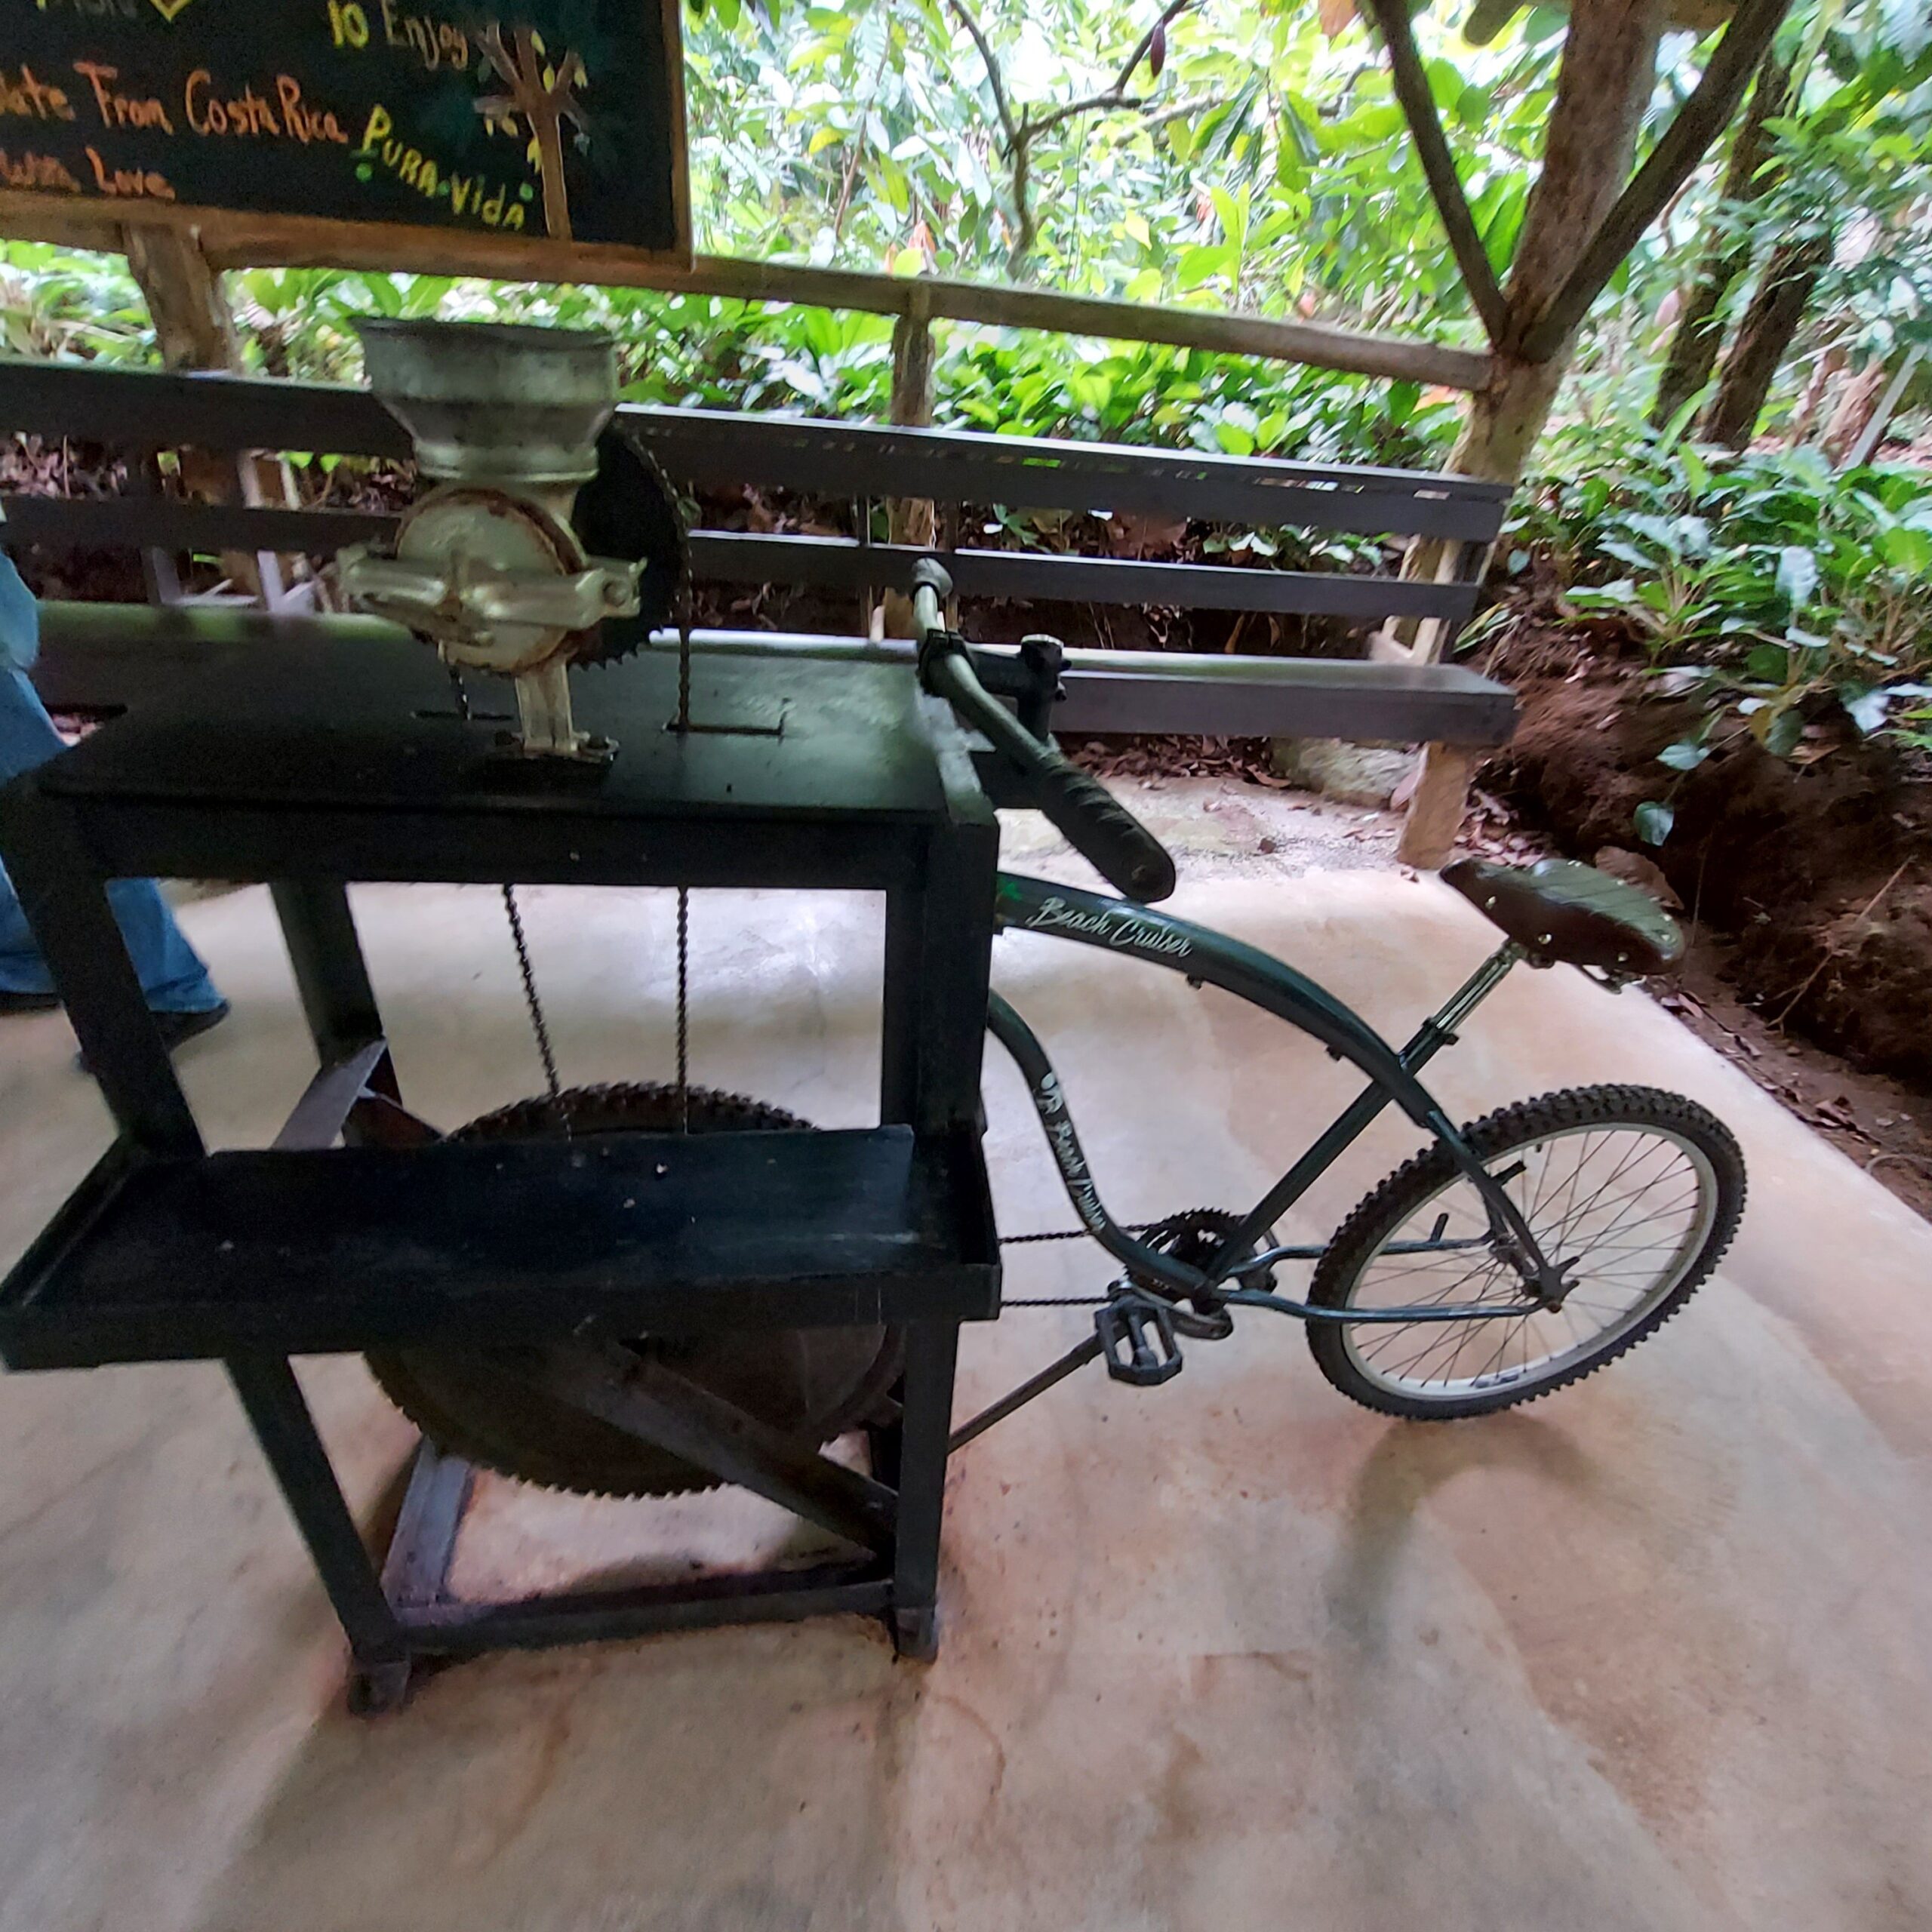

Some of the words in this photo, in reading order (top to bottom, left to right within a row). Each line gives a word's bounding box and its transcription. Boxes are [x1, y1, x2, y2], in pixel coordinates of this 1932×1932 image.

[186, 69, 280, 137] Costa
[276, 75, 349, 143] Rica
[1025, 897, 1111, 935] Beach
[1109, 919, 1193, 958] Cruiser
